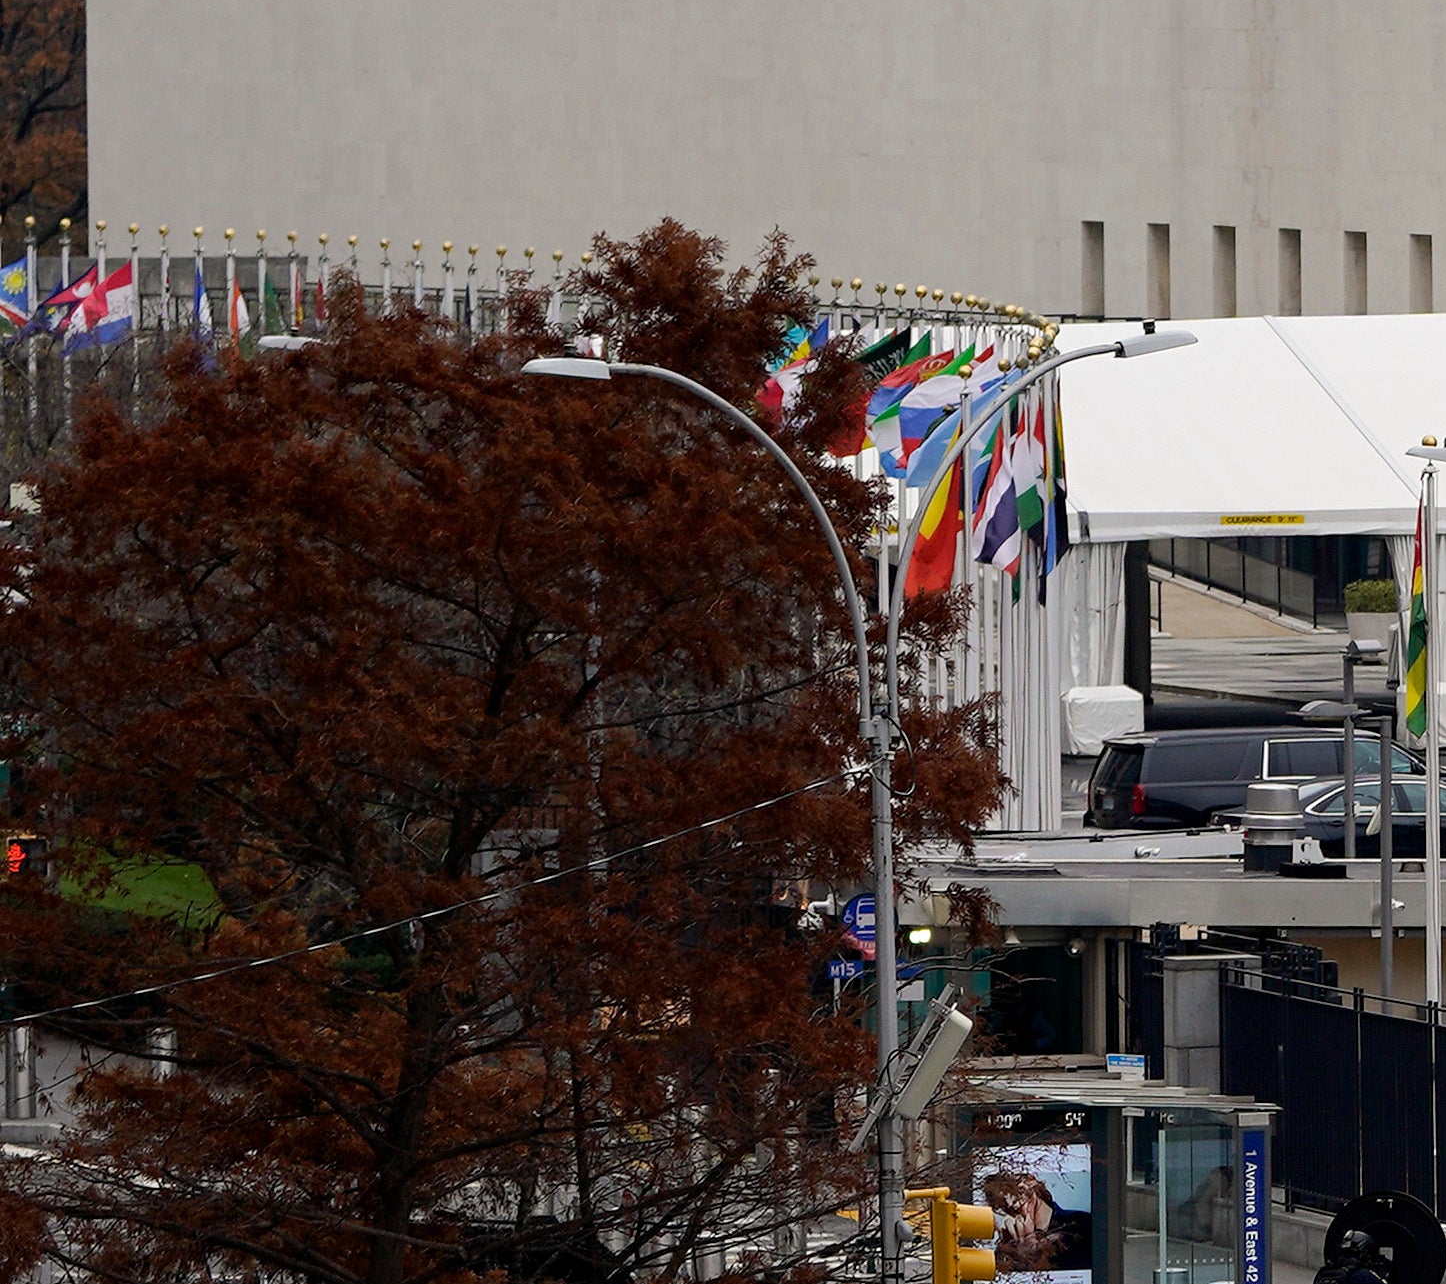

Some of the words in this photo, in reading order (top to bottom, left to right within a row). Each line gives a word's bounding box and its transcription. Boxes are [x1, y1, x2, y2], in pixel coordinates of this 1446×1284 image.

[830, 962, 856, 977] M15
[1245, 1149, 1257, 1157] 1
[1244, 1161, 1258, 1215] Avenue
[1245, 1216, 1258, 1228] &
[1245, 1231, 1258, 1262] East
[1246, 1265, 1258, 1283] 42
